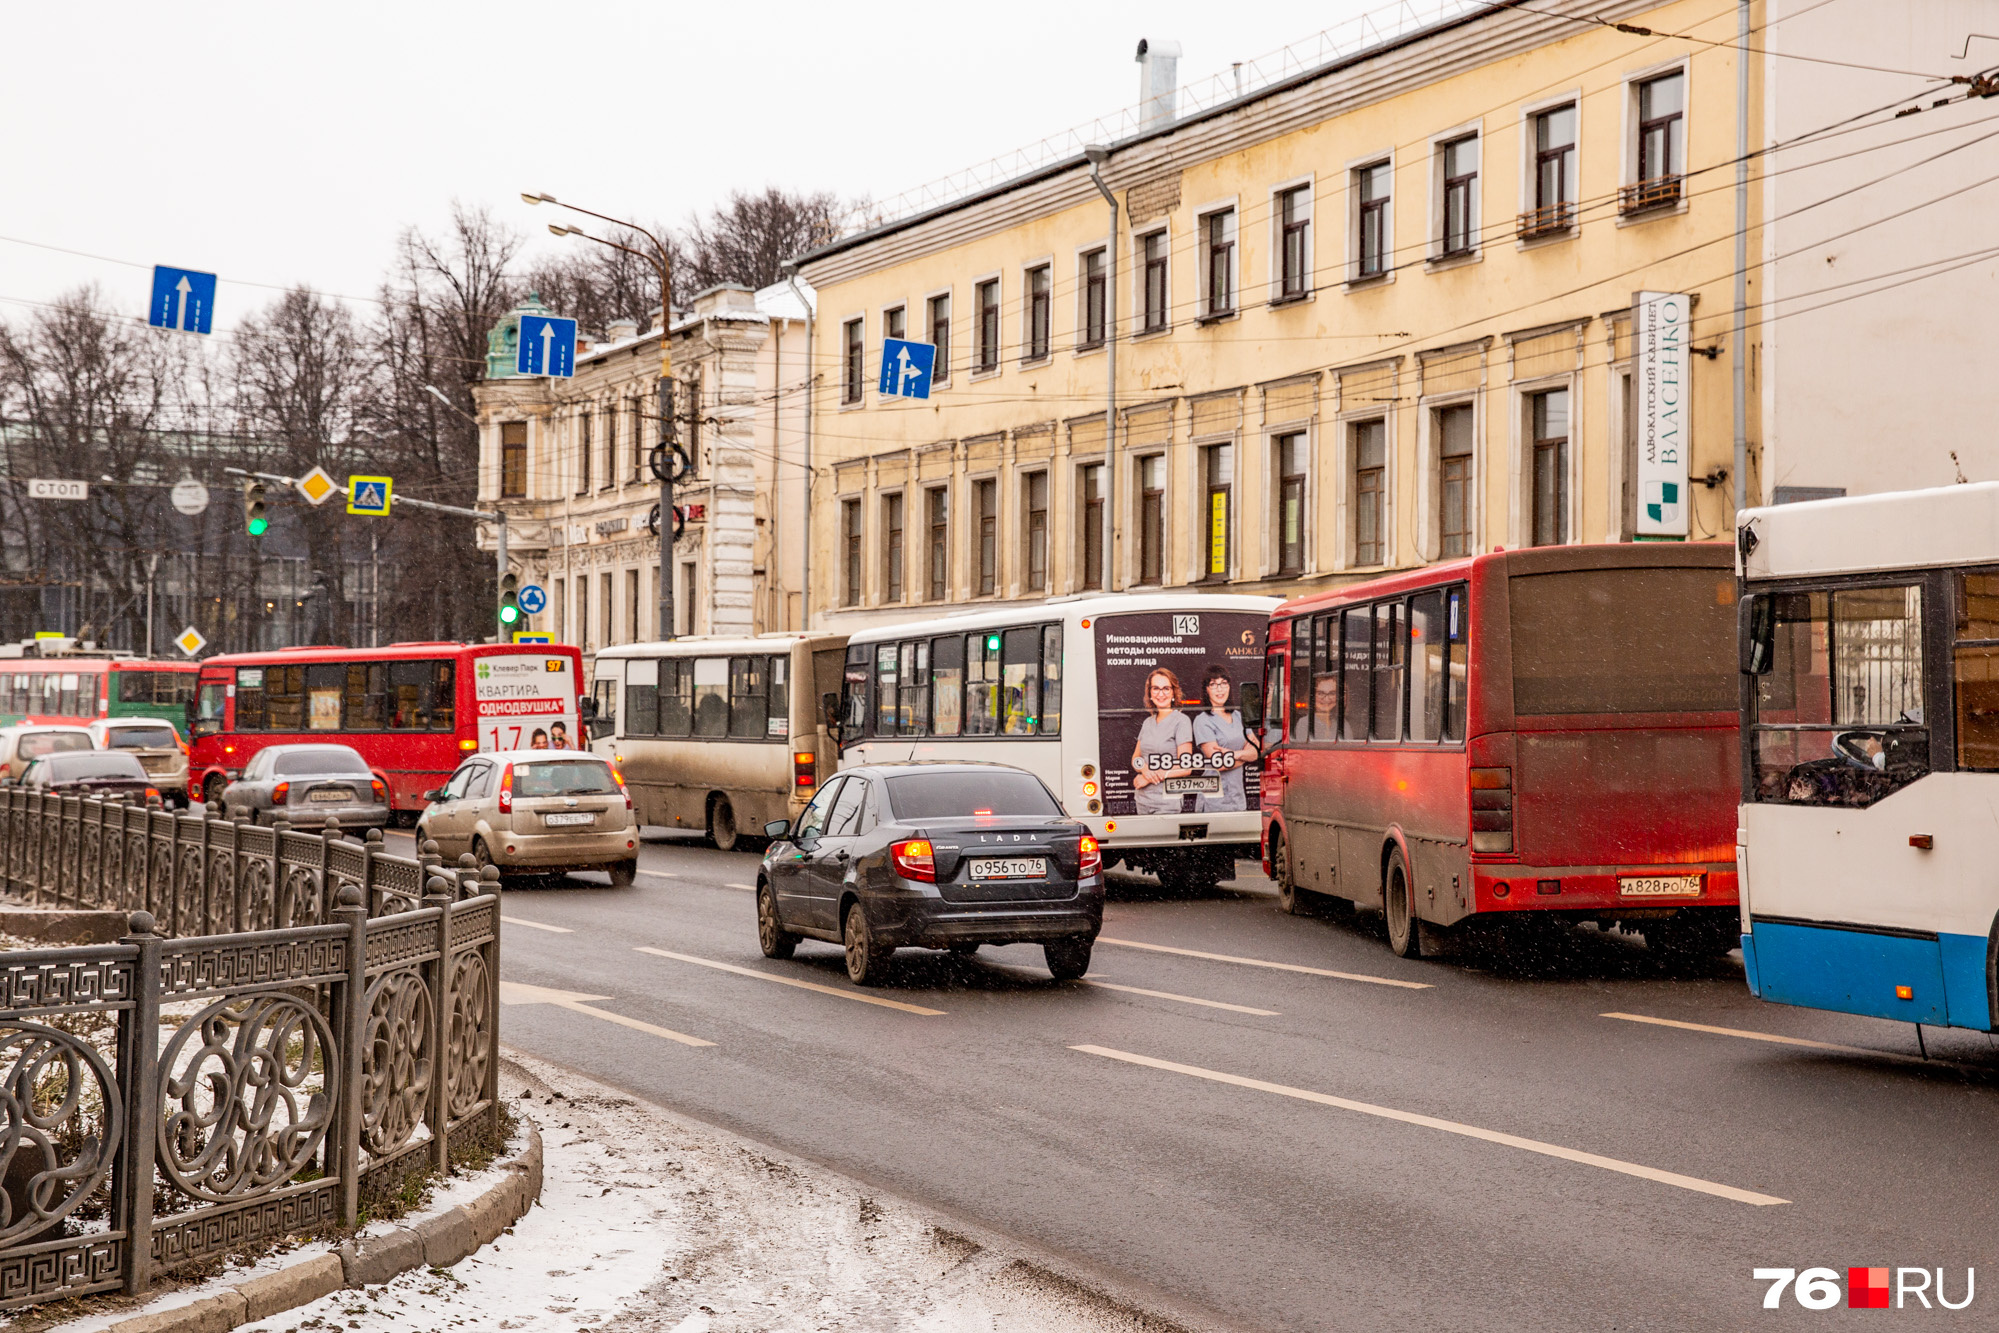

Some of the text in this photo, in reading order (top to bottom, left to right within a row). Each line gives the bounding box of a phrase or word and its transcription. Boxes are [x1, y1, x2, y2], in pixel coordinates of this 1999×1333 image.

[1646, 302, 1657, 465] АДВОКАТСКИЙ КАБИНЕТ
[1661, 301, 1679, 465] ВЛАСЕНКО
[35, 483, 80, 496] СТОП
[1174, 616, 1199, 634] 143
[1106, 634, 1183, 644] Инновационные
[1106, 646, 1206, 656] методы омоложения
[492, 664, 539, 673] Клевер Парк
[546, 660, 562, 672] 97
[1106, 657, 1157, 667] кожи лица
[478, 684, 540, 697] КВАРТИРА
[1149, 752, 1235, 770] 58-88-66
[1169, 778, 1205, 790] Е937МО
[980, 834, 1037, 842] LADA
[975, 859, 1042, 874] О956ТО 76
[1626, 879, 1680, 893] А828РО
